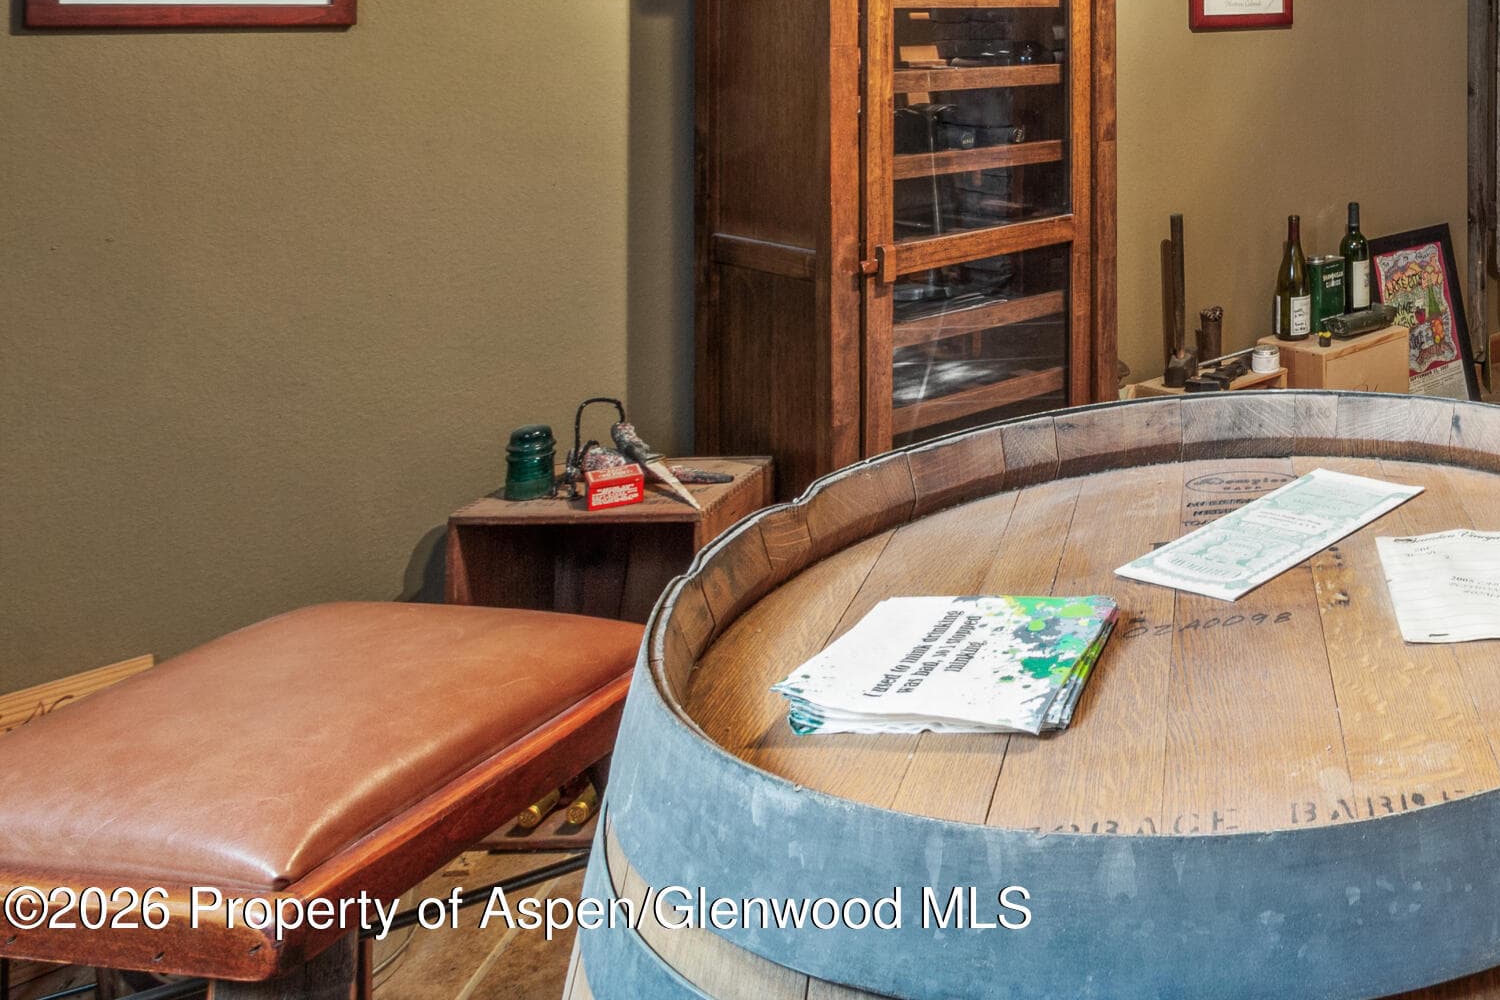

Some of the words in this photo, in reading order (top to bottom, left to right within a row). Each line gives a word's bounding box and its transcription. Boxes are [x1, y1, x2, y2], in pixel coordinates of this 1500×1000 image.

[923, 610, 965, 643] drinking
[896, 678, 923, 694] was
[911, 659, 944, 677] bad,
[946, 615, 982, 645] stopped
[900, 644, 933, 664] think
[890, 664, 911, 673] to
[871, 674, 902, 693] used
